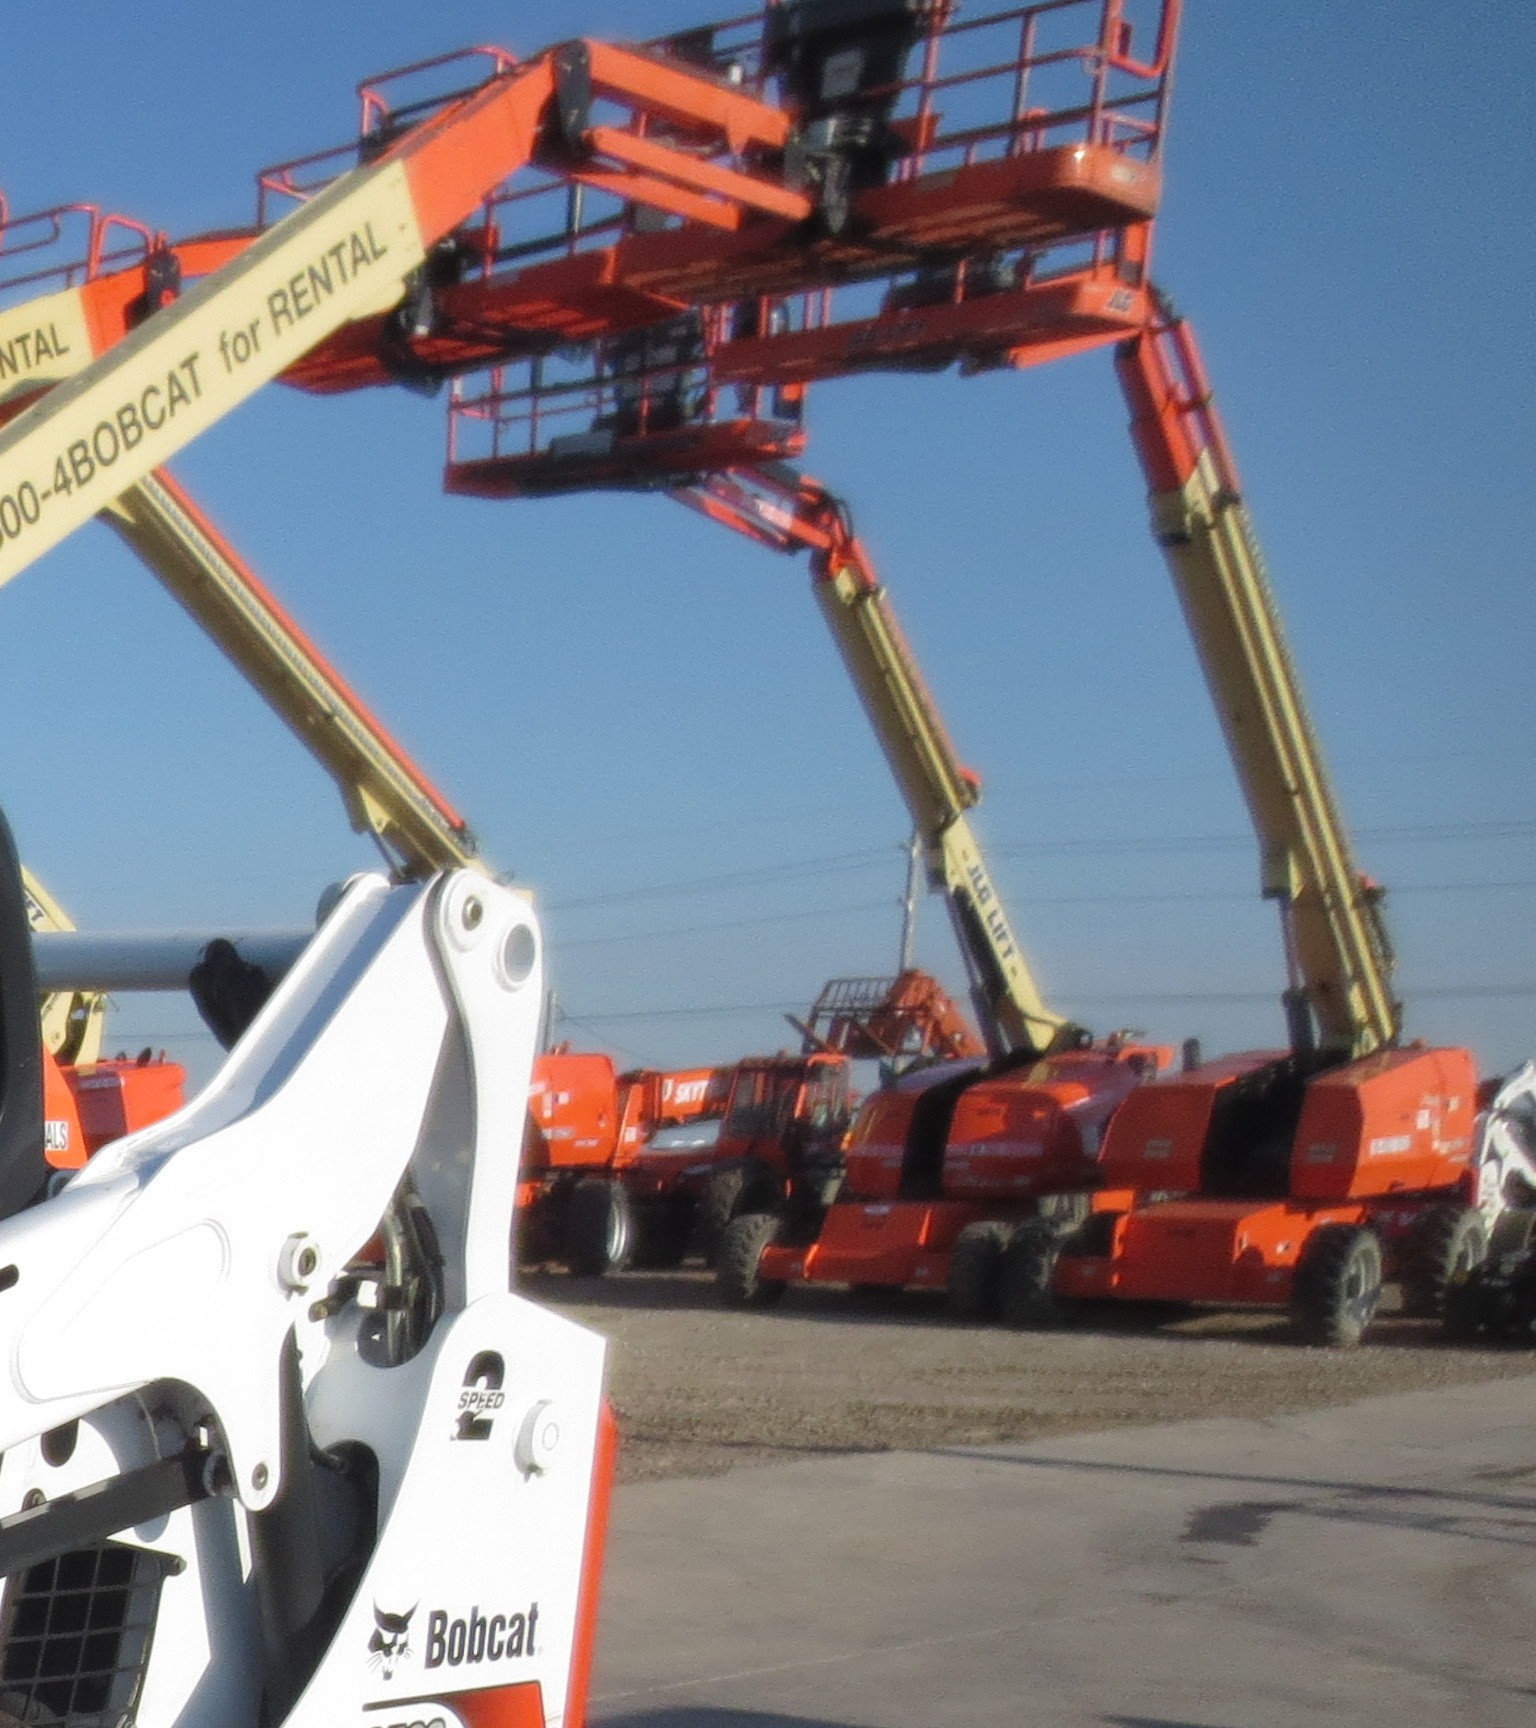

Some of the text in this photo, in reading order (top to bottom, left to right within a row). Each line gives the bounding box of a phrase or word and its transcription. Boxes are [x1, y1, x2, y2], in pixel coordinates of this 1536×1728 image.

[218, 318, 262, 373] for
[266, 221, 389, 338] RENTAL
[457, 1391, 505, 1409] SPEED
[424, 1602, 539, 1670] Bobcat
